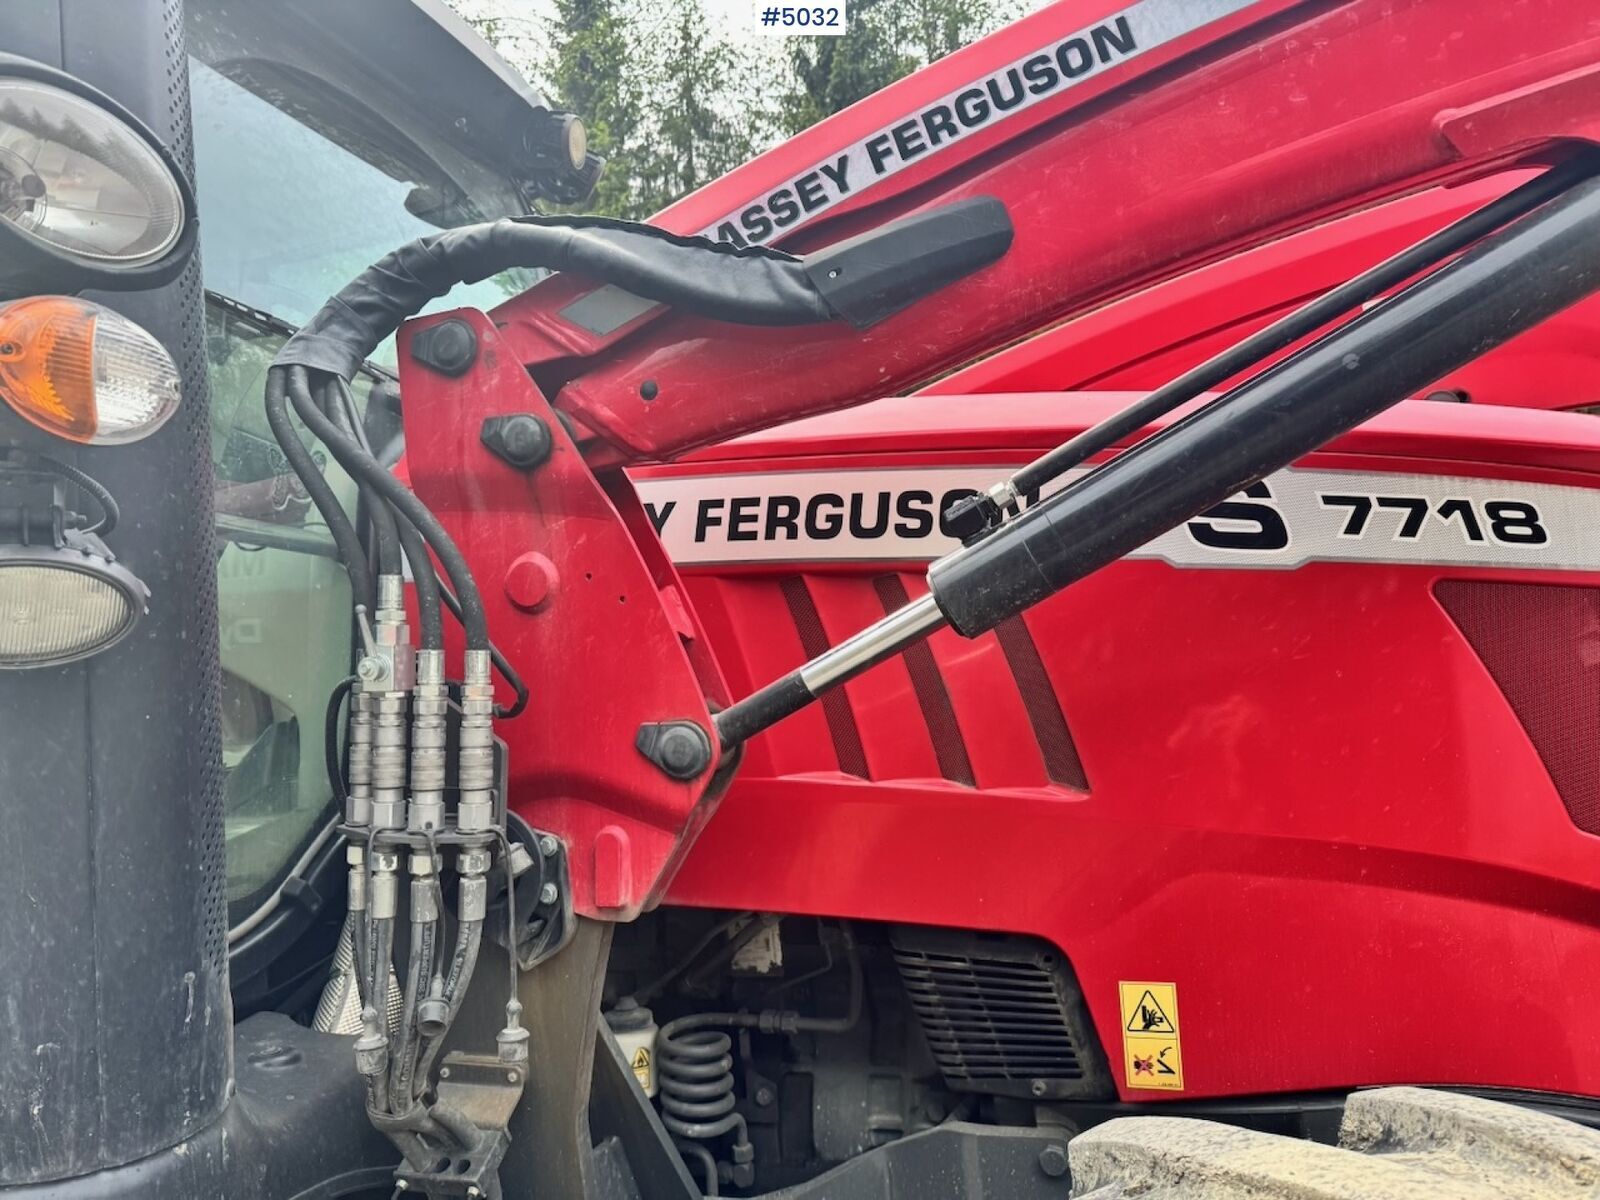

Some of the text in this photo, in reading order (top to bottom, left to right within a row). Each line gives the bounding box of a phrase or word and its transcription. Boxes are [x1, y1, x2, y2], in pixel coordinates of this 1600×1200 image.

[704, 15, 1138, 250] ASSEY FERGUSON
[694, 487, 1041, 543] FERGUS
[1320, 494, 1548, 544] 7718
